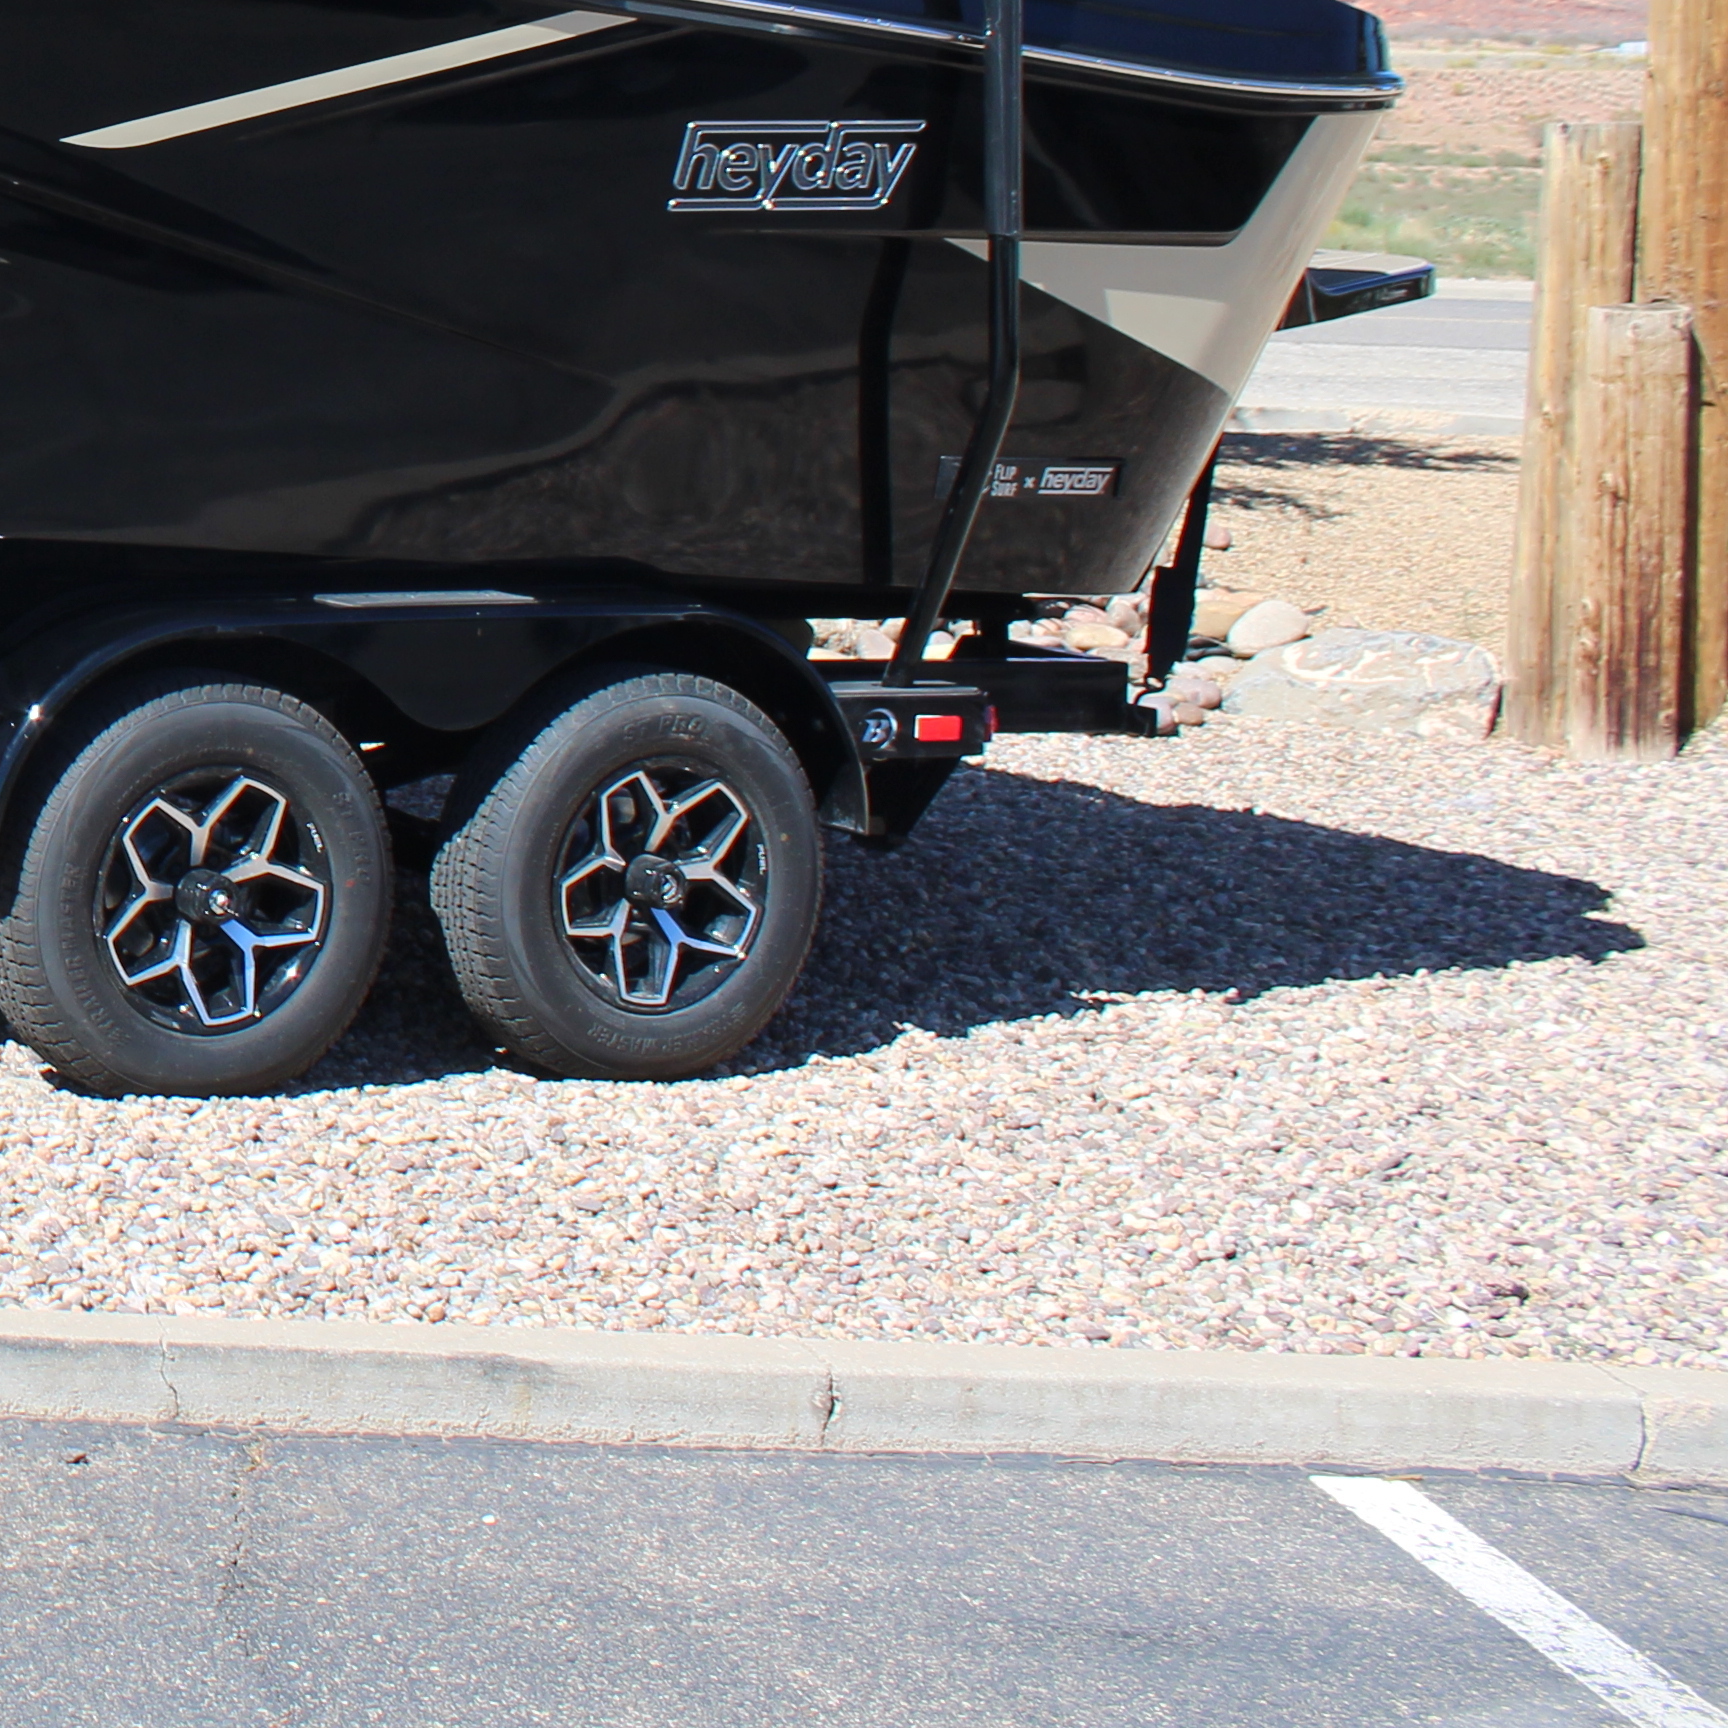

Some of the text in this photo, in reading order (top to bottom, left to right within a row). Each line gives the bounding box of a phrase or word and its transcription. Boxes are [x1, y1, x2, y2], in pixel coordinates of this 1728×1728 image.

[667, 120, 928, 211] heyday
[994, 464, 1017, 480] FLIP
[1038, 467, 1114, 495] heyday
[660, 714, 704, 733] PRO
